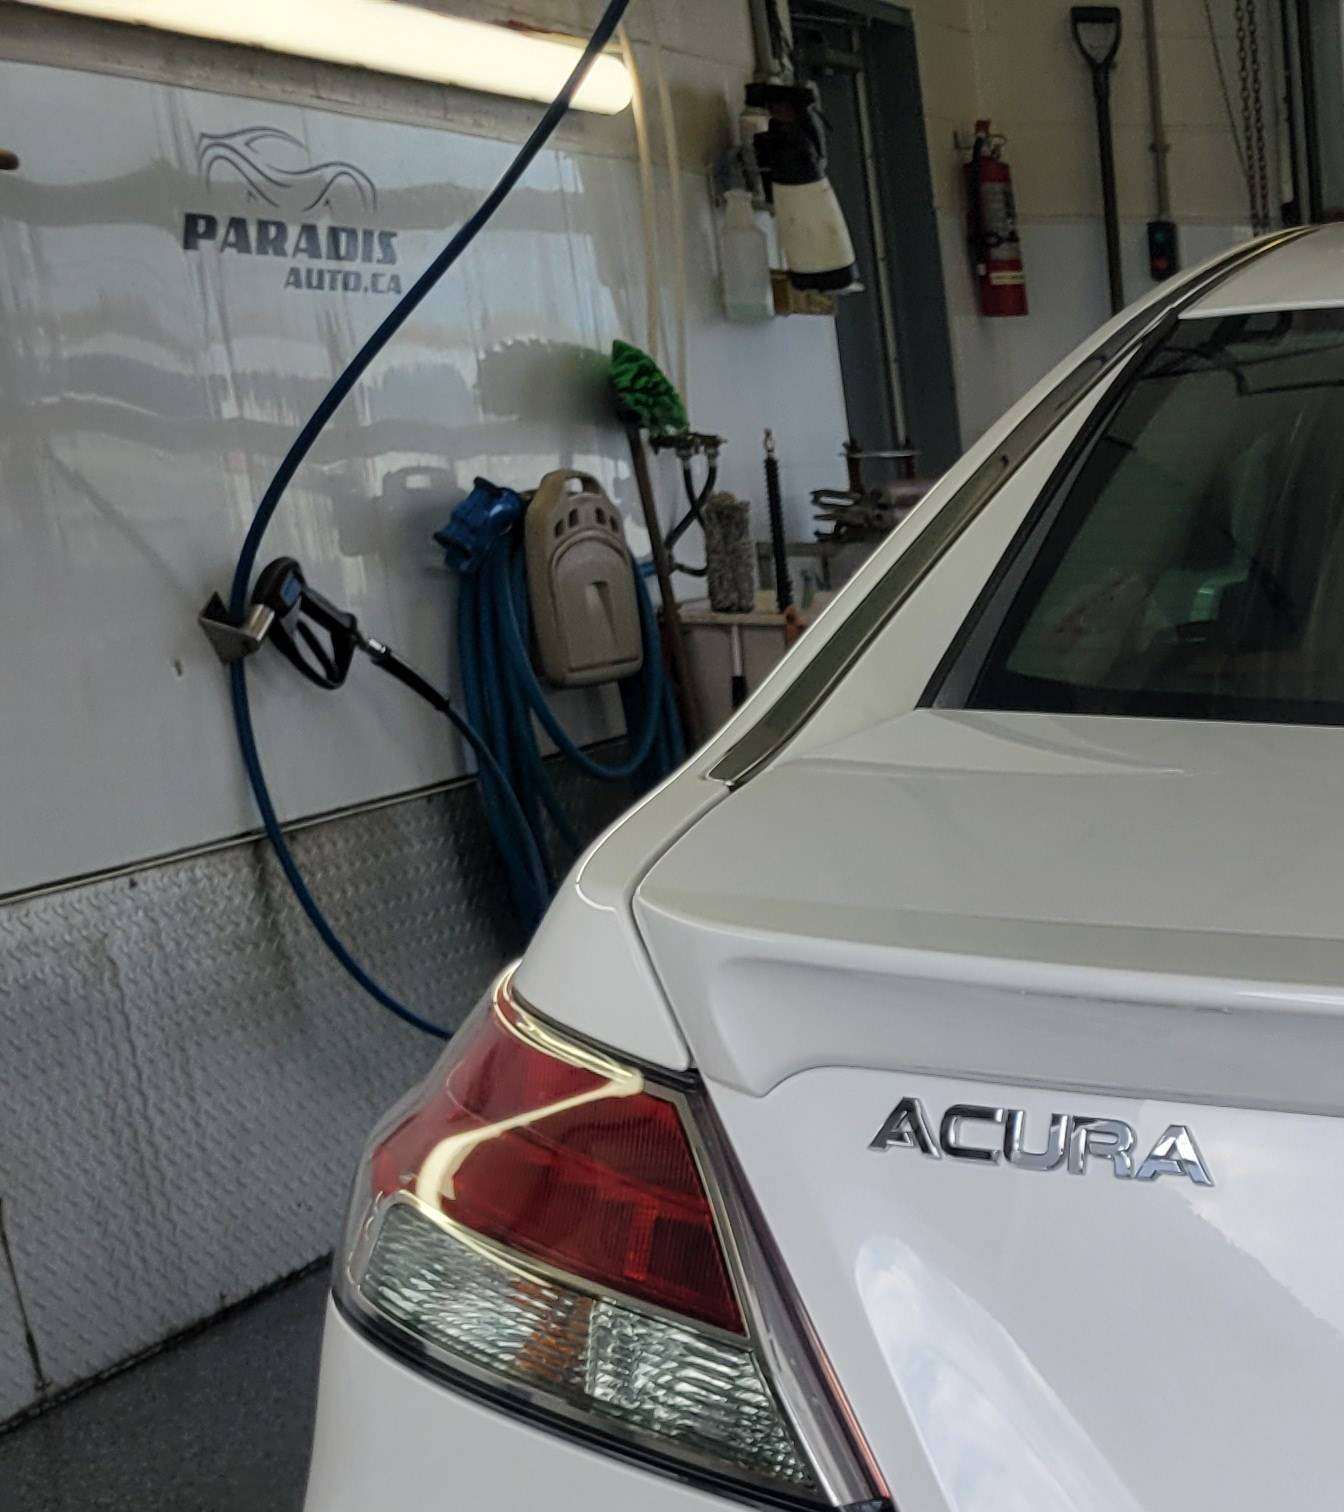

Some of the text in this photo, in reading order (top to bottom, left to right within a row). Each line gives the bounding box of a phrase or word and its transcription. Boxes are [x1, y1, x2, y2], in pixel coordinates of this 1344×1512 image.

[183, 213, 398, 265] PARADIS
[285, 267, 402, 295] AUTO.CA
[868, 1096, 1216, 1187] ACURA
